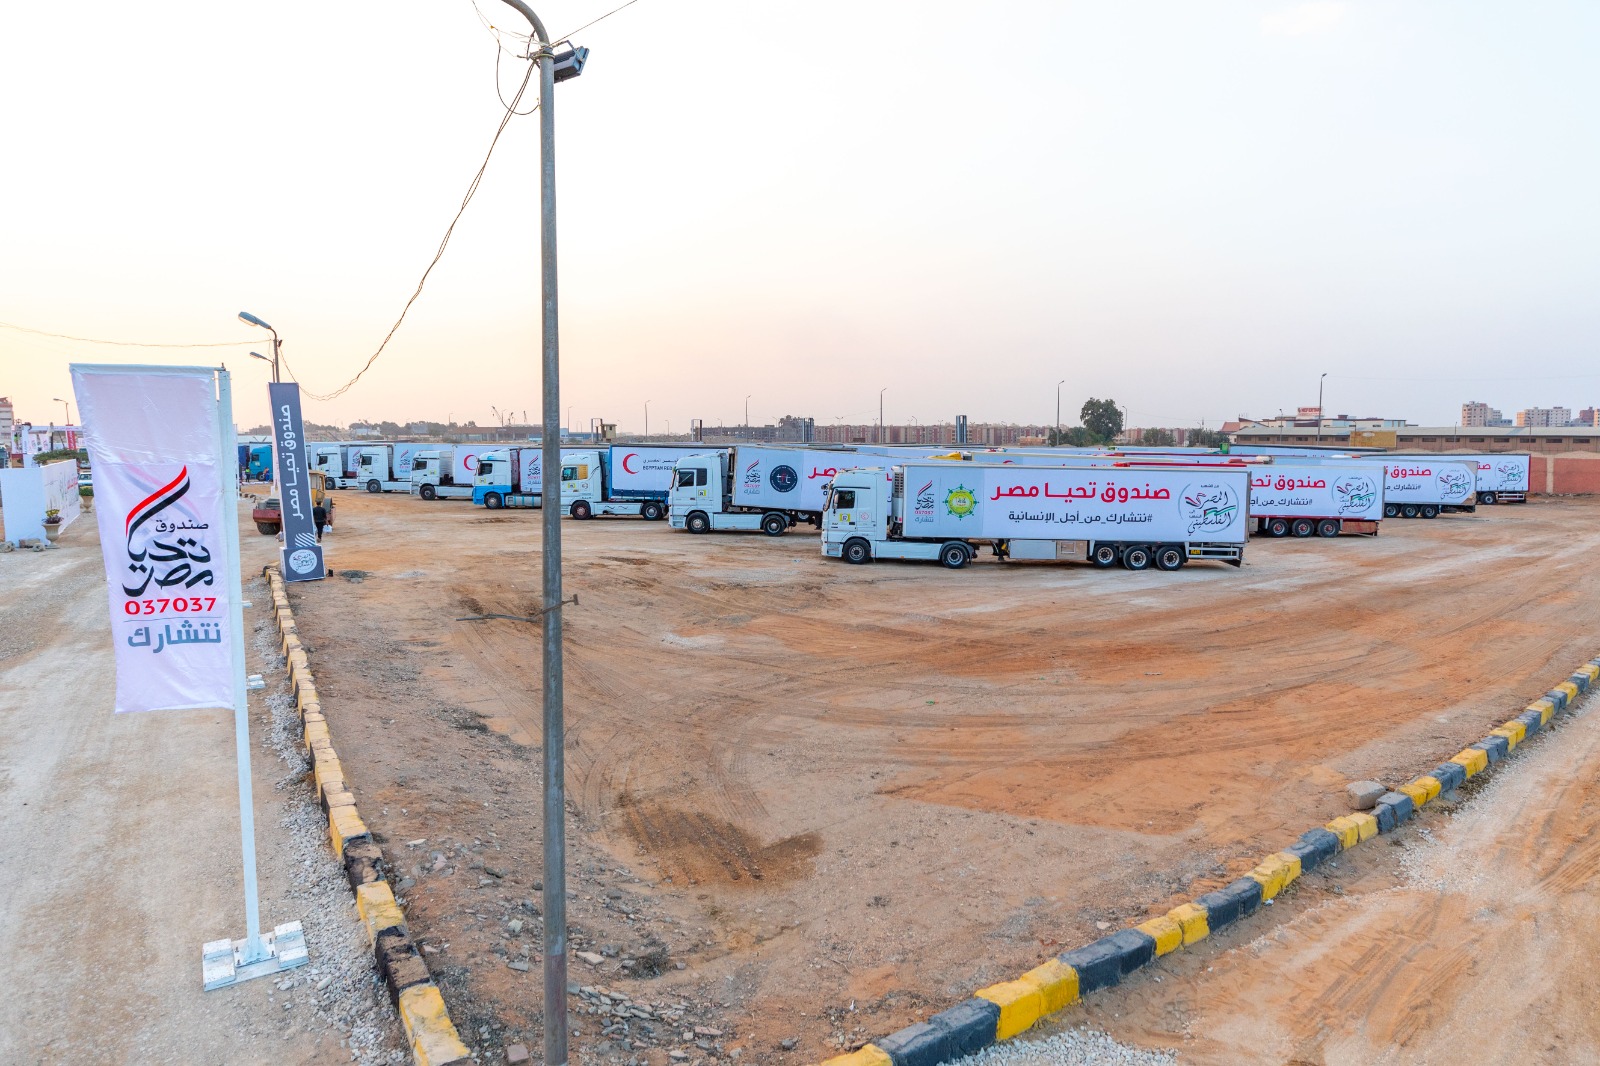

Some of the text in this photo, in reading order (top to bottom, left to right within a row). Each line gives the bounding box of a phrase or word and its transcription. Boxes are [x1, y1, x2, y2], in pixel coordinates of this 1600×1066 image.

[278, 404, 305, 521] صندوق تحيا مصر
[1390, 465, 1432, 479] صندوق
[807, 467, 837, 479] صر
[990, 482, 1170, 503] صندوق تحيا مصر
[1274, 475, 1327, 491] صندوق
[155, 519, 209, 533] صندوق
[122, 562, 214, 598] مصر
[124, 597, 217, 616] 037037
[127, 619, 222, 654] نتشارك
